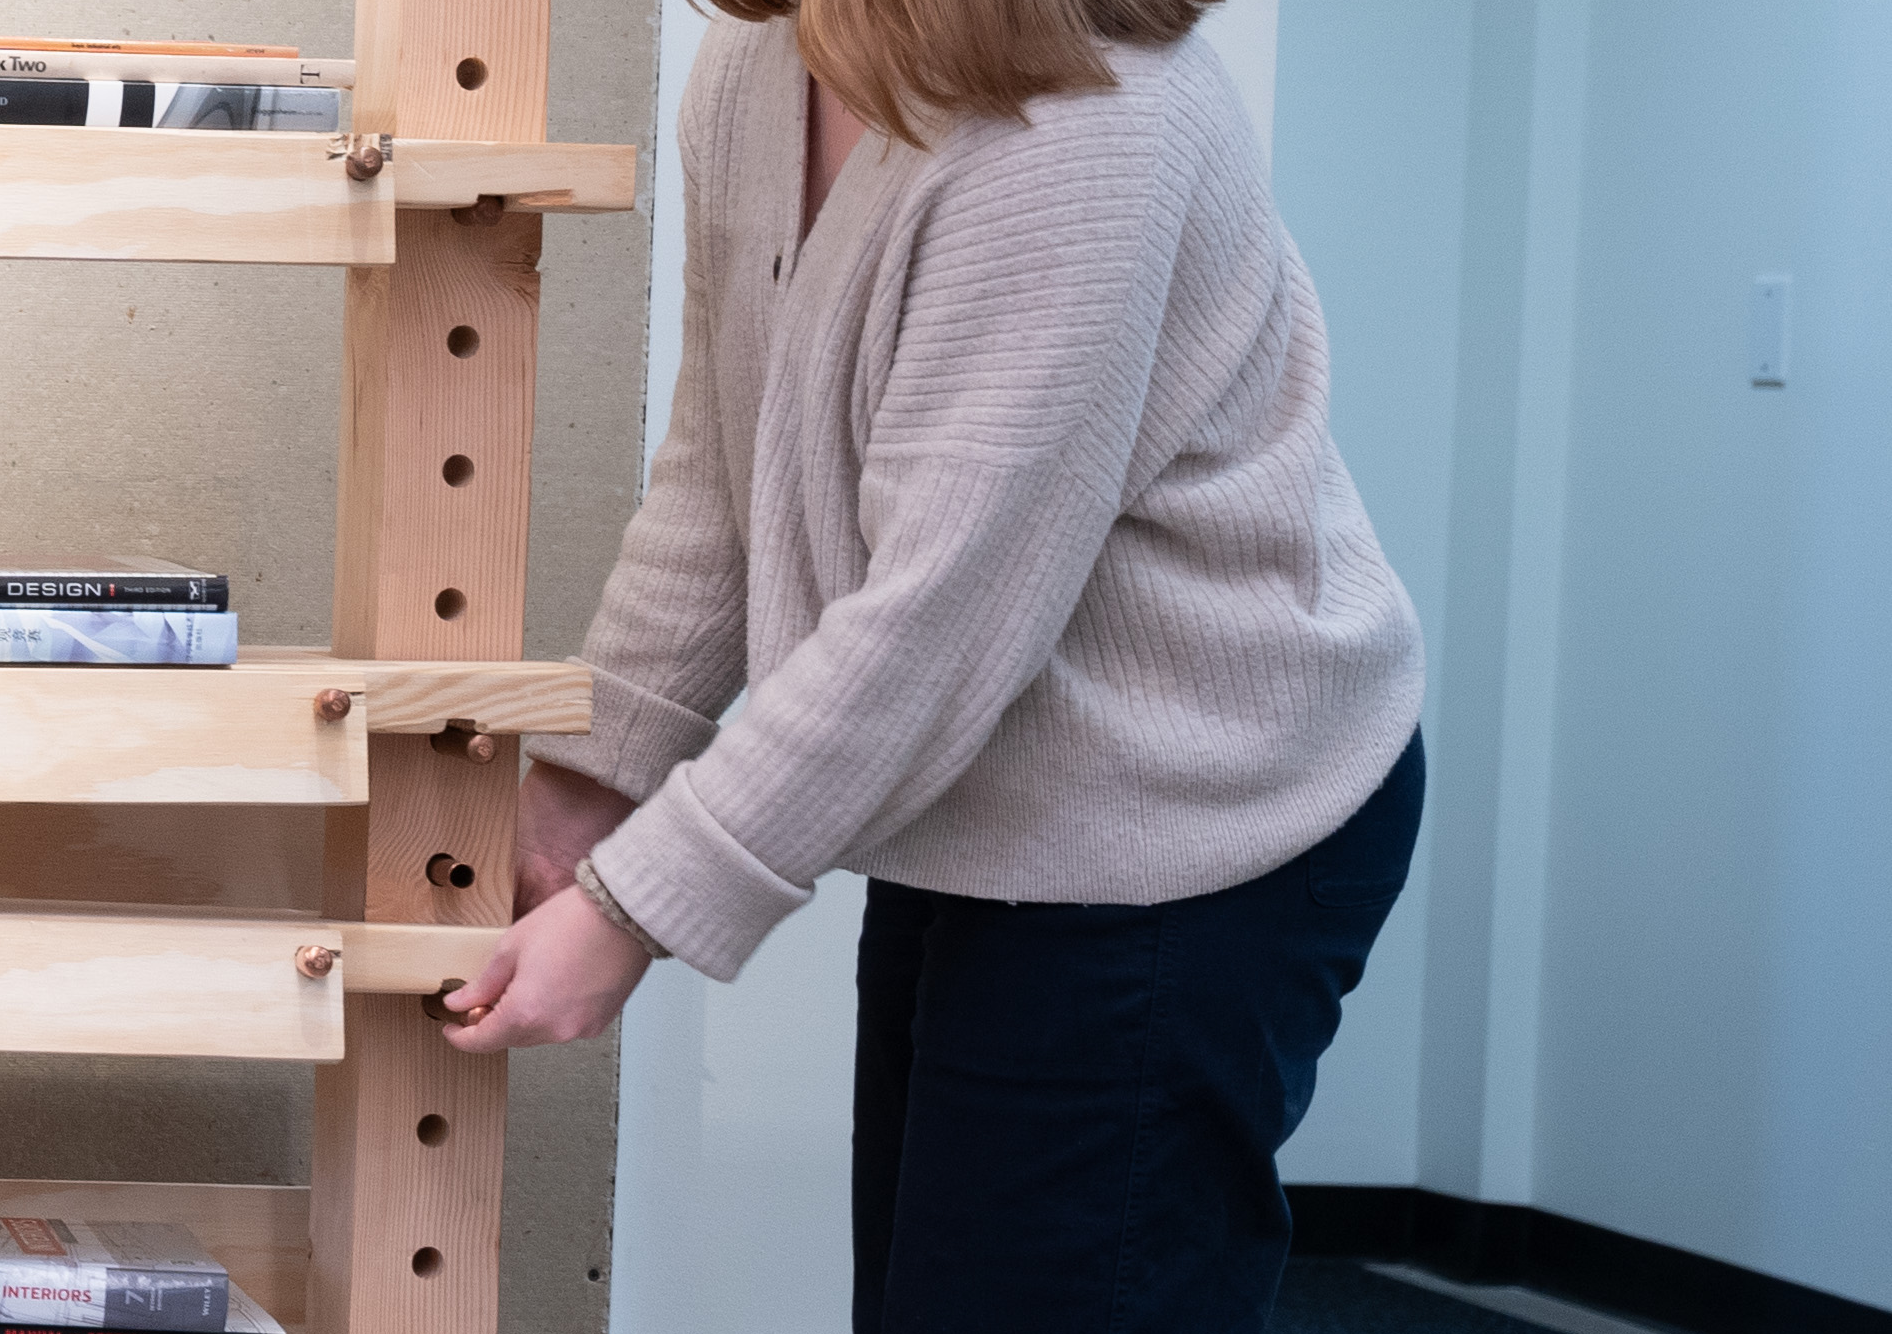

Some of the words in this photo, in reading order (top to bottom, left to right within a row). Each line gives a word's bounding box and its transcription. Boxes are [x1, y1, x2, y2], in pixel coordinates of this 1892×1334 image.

[9, 56, 47, 73] Two
[7, 582, 102, 597] DESIGN
[2, 1285, 92, 1303] INTERIORS
[201, 1287, 212, 1317] WILEY
